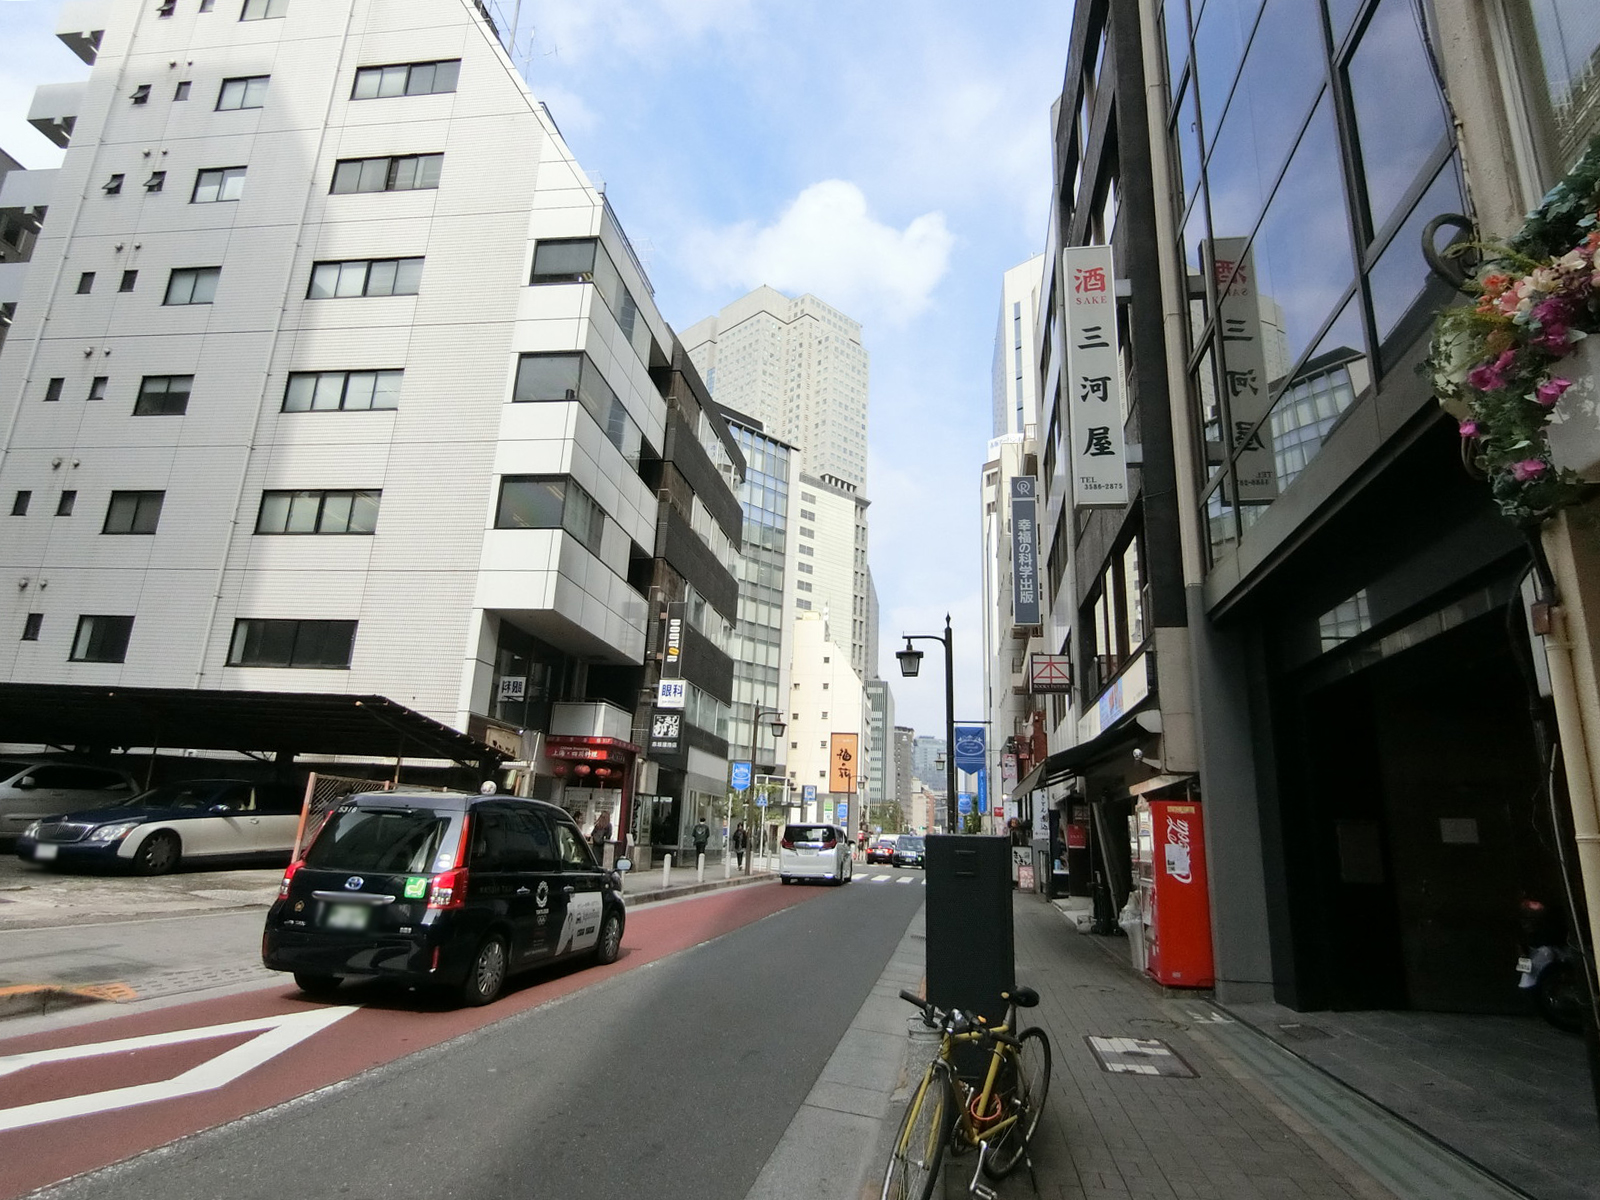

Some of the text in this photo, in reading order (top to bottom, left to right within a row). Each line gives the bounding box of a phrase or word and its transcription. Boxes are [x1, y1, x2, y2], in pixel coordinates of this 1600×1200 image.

[1074, 266, 1106, 294] 酒
[1075, 295, 1107, 306] SAKE
[1077, 325, 1116, 457] 三河屋
[1080, 476, 1097, 484] TEL
[1084, 483, 1123, 491] 3586-2875
[1017, 518, 1034, 604] 幸福の科学出版
[666, 618, 681, 663] DOUTOR
[661, 684, 683, 698] 眼科
